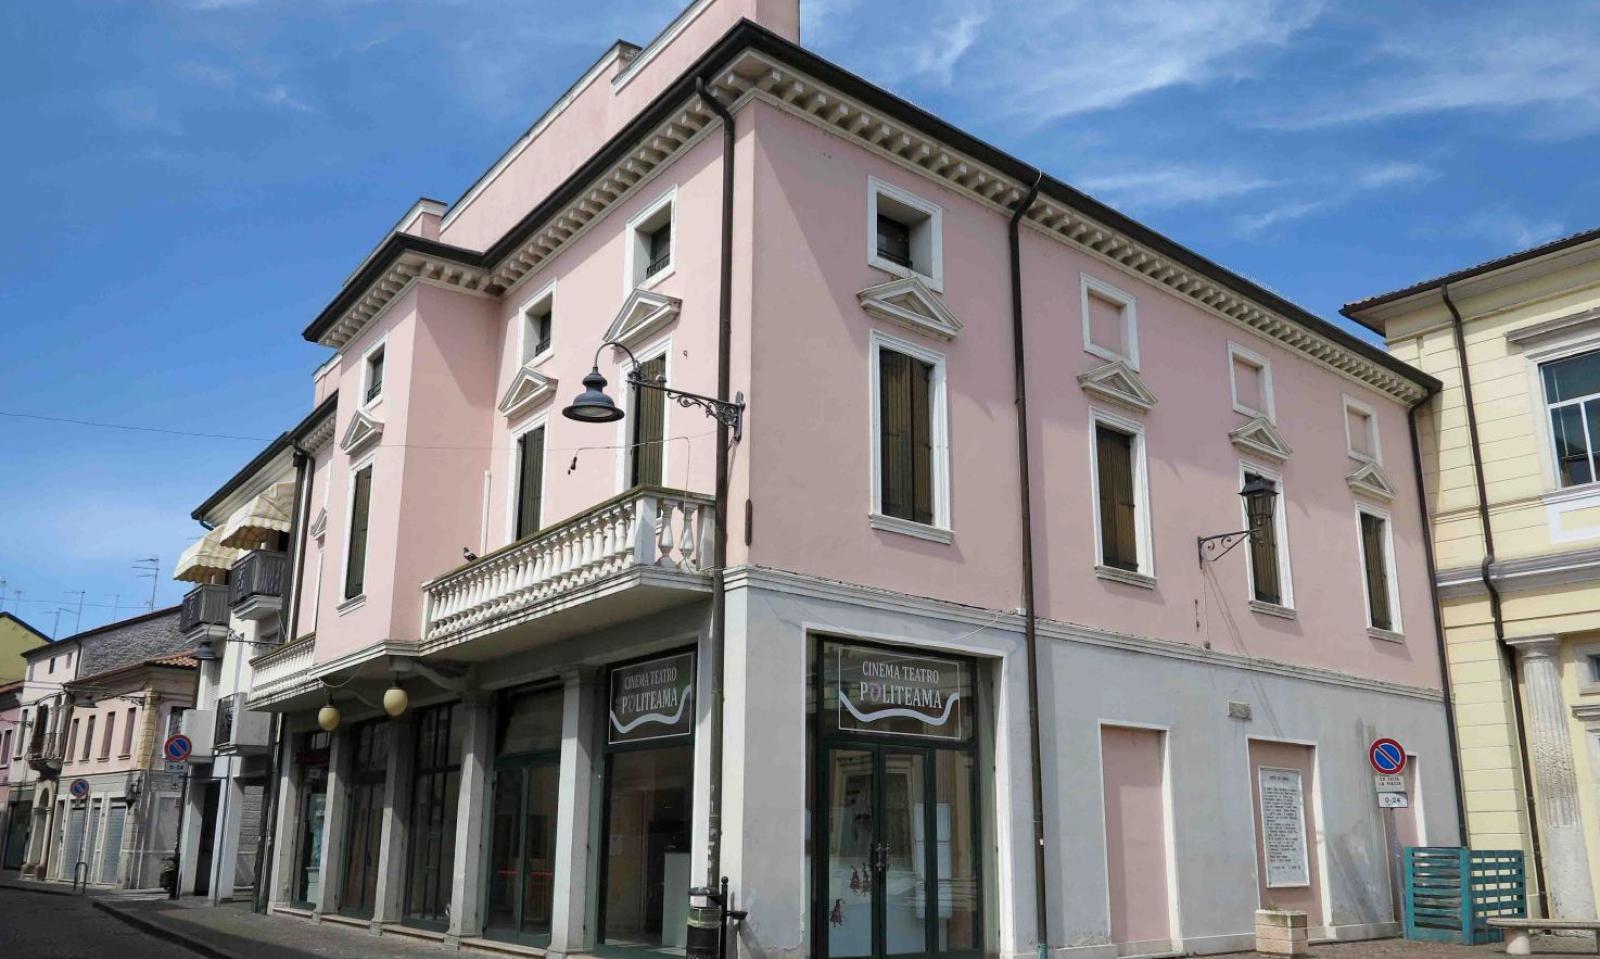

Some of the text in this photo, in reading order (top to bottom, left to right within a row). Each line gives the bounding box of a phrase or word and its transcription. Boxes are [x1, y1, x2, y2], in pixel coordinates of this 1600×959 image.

[624, 666, 677, 690] CINEMA TEATRO
[862, 661, 940, 684] CINEMA TEATRO
[622, 687, 678, 714] POLITEAMA
[860, 681, 943, 709] POLITEAMA
